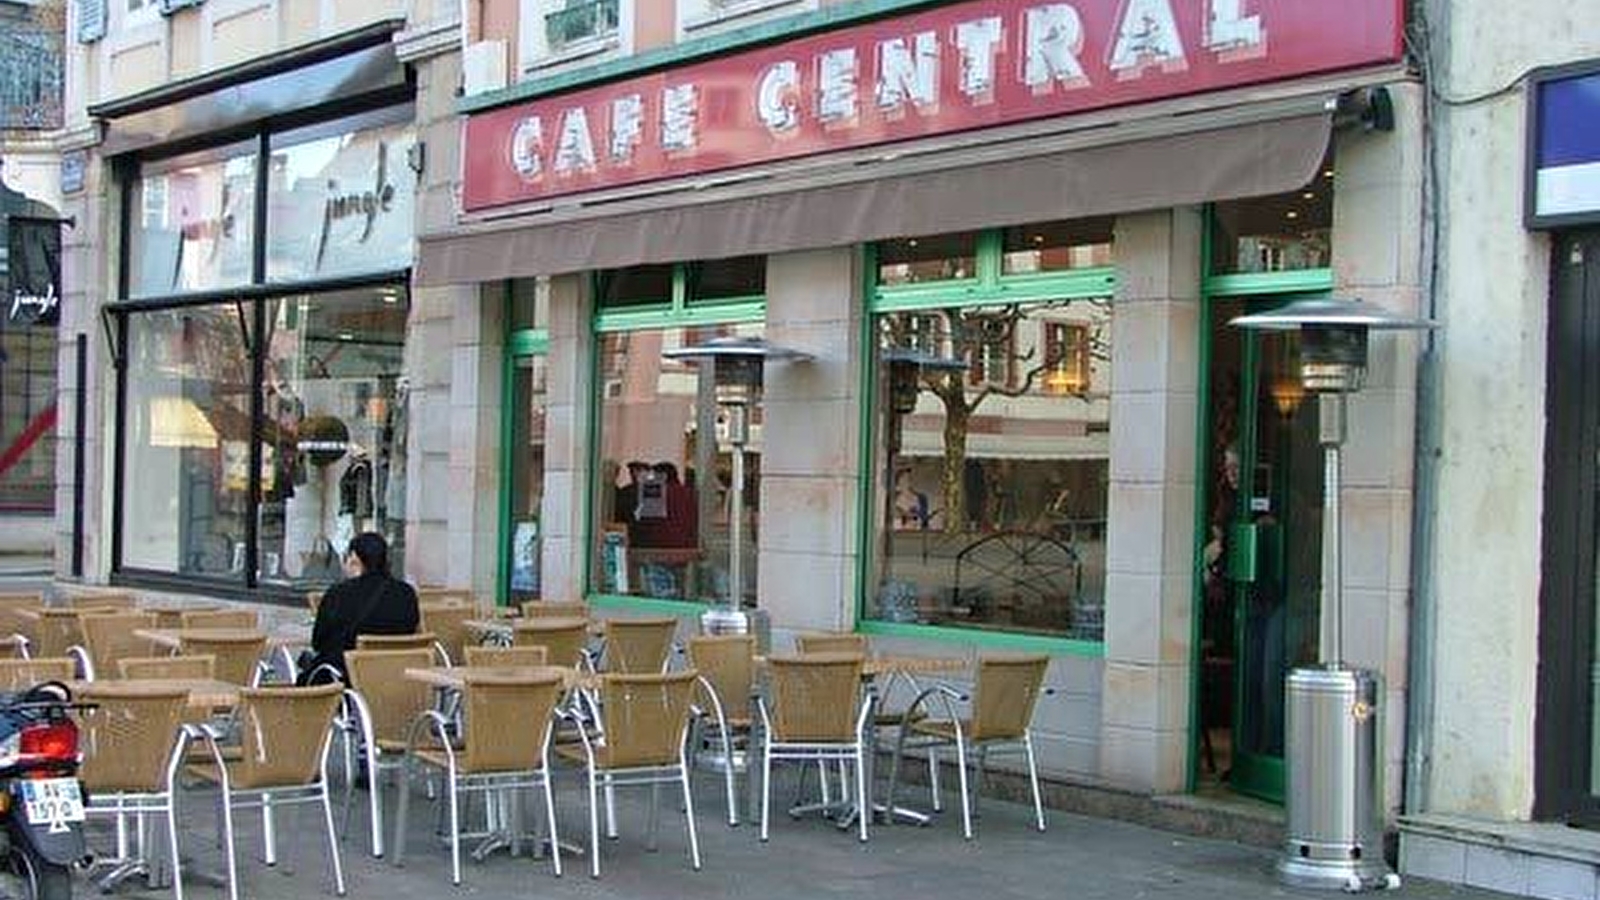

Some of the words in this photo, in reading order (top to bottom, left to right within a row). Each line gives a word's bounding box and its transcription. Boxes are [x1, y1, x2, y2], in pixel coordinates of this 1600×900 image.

[511, 83, 698, 180] CAFE
[757, 0, 1264, 132] CENTRAL
[316, 141, 394, 272] jungle
[10, 283, 58, 319] jungle
